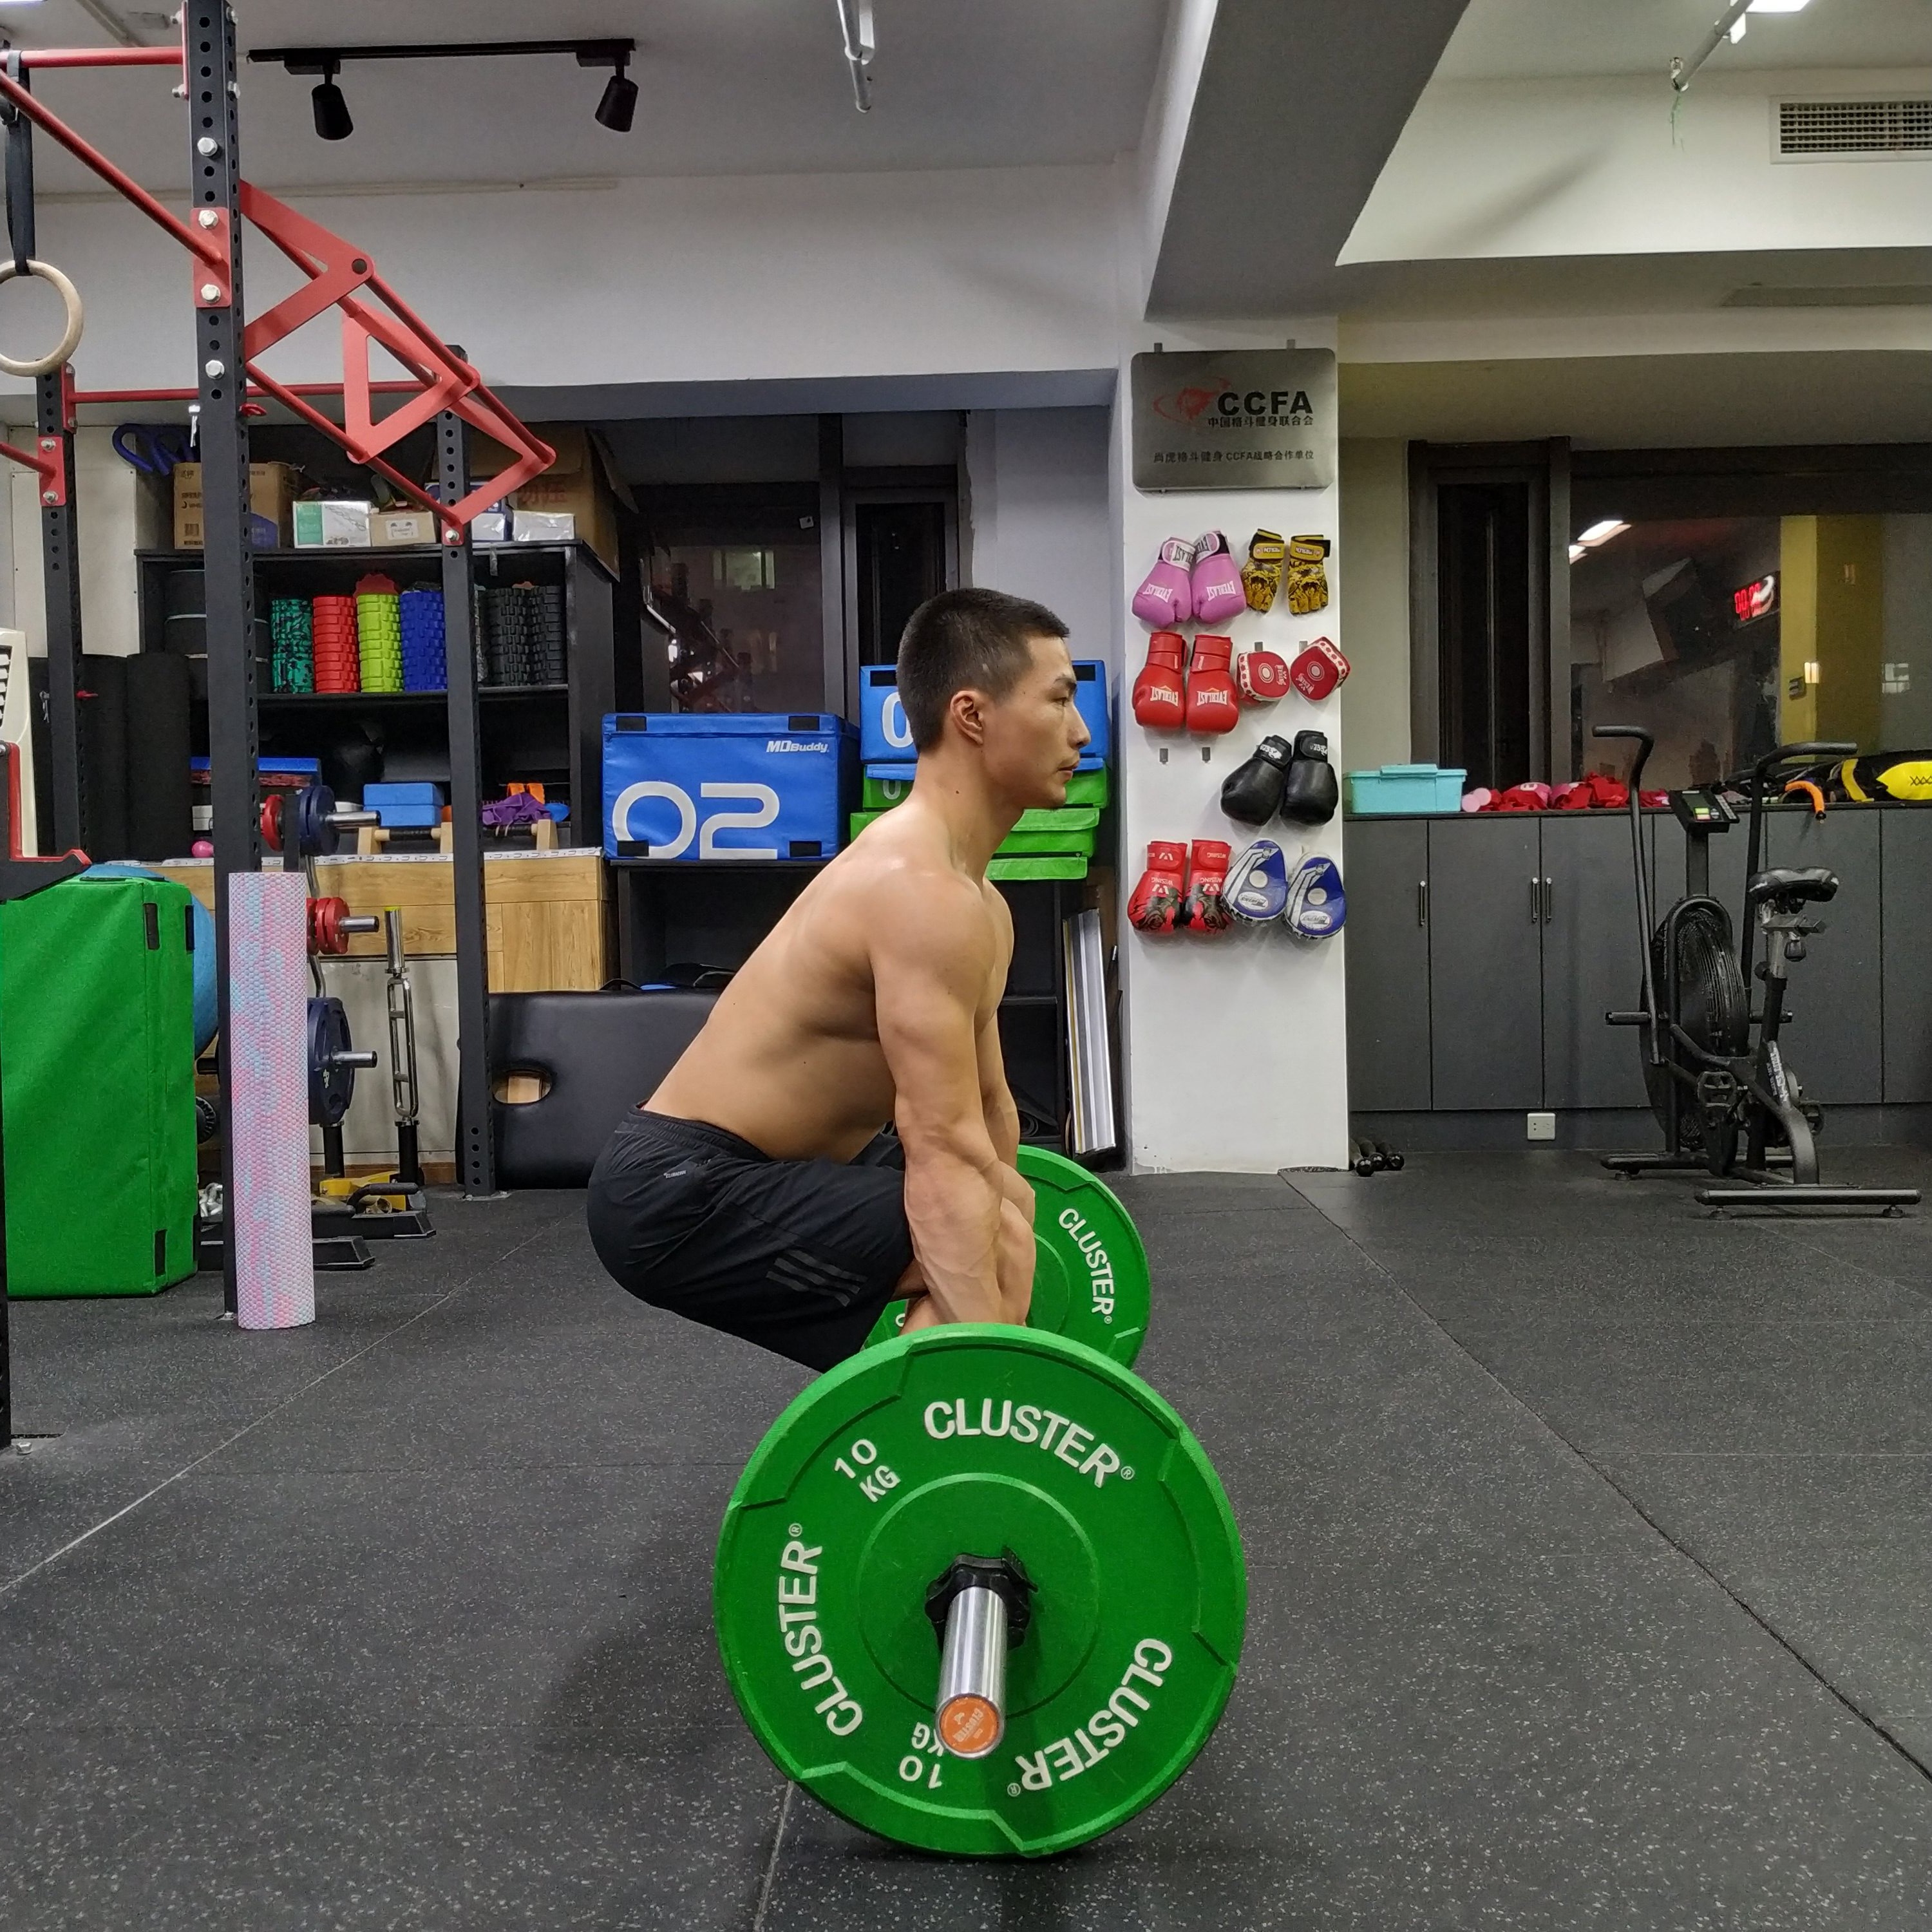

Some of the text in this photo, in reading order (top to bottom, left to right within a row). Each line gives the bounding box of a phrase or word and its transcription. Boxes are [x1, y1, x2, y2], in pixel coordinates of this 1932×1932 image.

[1217, 390, 1313, 416] CCFA
[1208, 415, 1313, 429] 中国格斗健身联合会
[1142, 583, 1173, 603] EVERLAST
[1206, 581, 1236, 601] EVERLAST
[1150, 686, 1179, 706] EVERLAST
[1197, 688, 1228, 706] EVERLAST
[766, 740, 829, 753] MDBuddy
[612, 781, 780, 860] 02
[1059, 1208, 1114, 1315] CLUSTER
[834, 1439, 878, 1479] 10
[924, 1398, 1121, 1488] CLUSTER
[858, 1465, 901, 1502] KG
[778, 1540, 864, 1736] CLUSTER
[1014, 1638, 1173, 1791] CLUSTER
[911, 1721, 944, 1757] KG
[899, 1755, 942, 1789] 10
